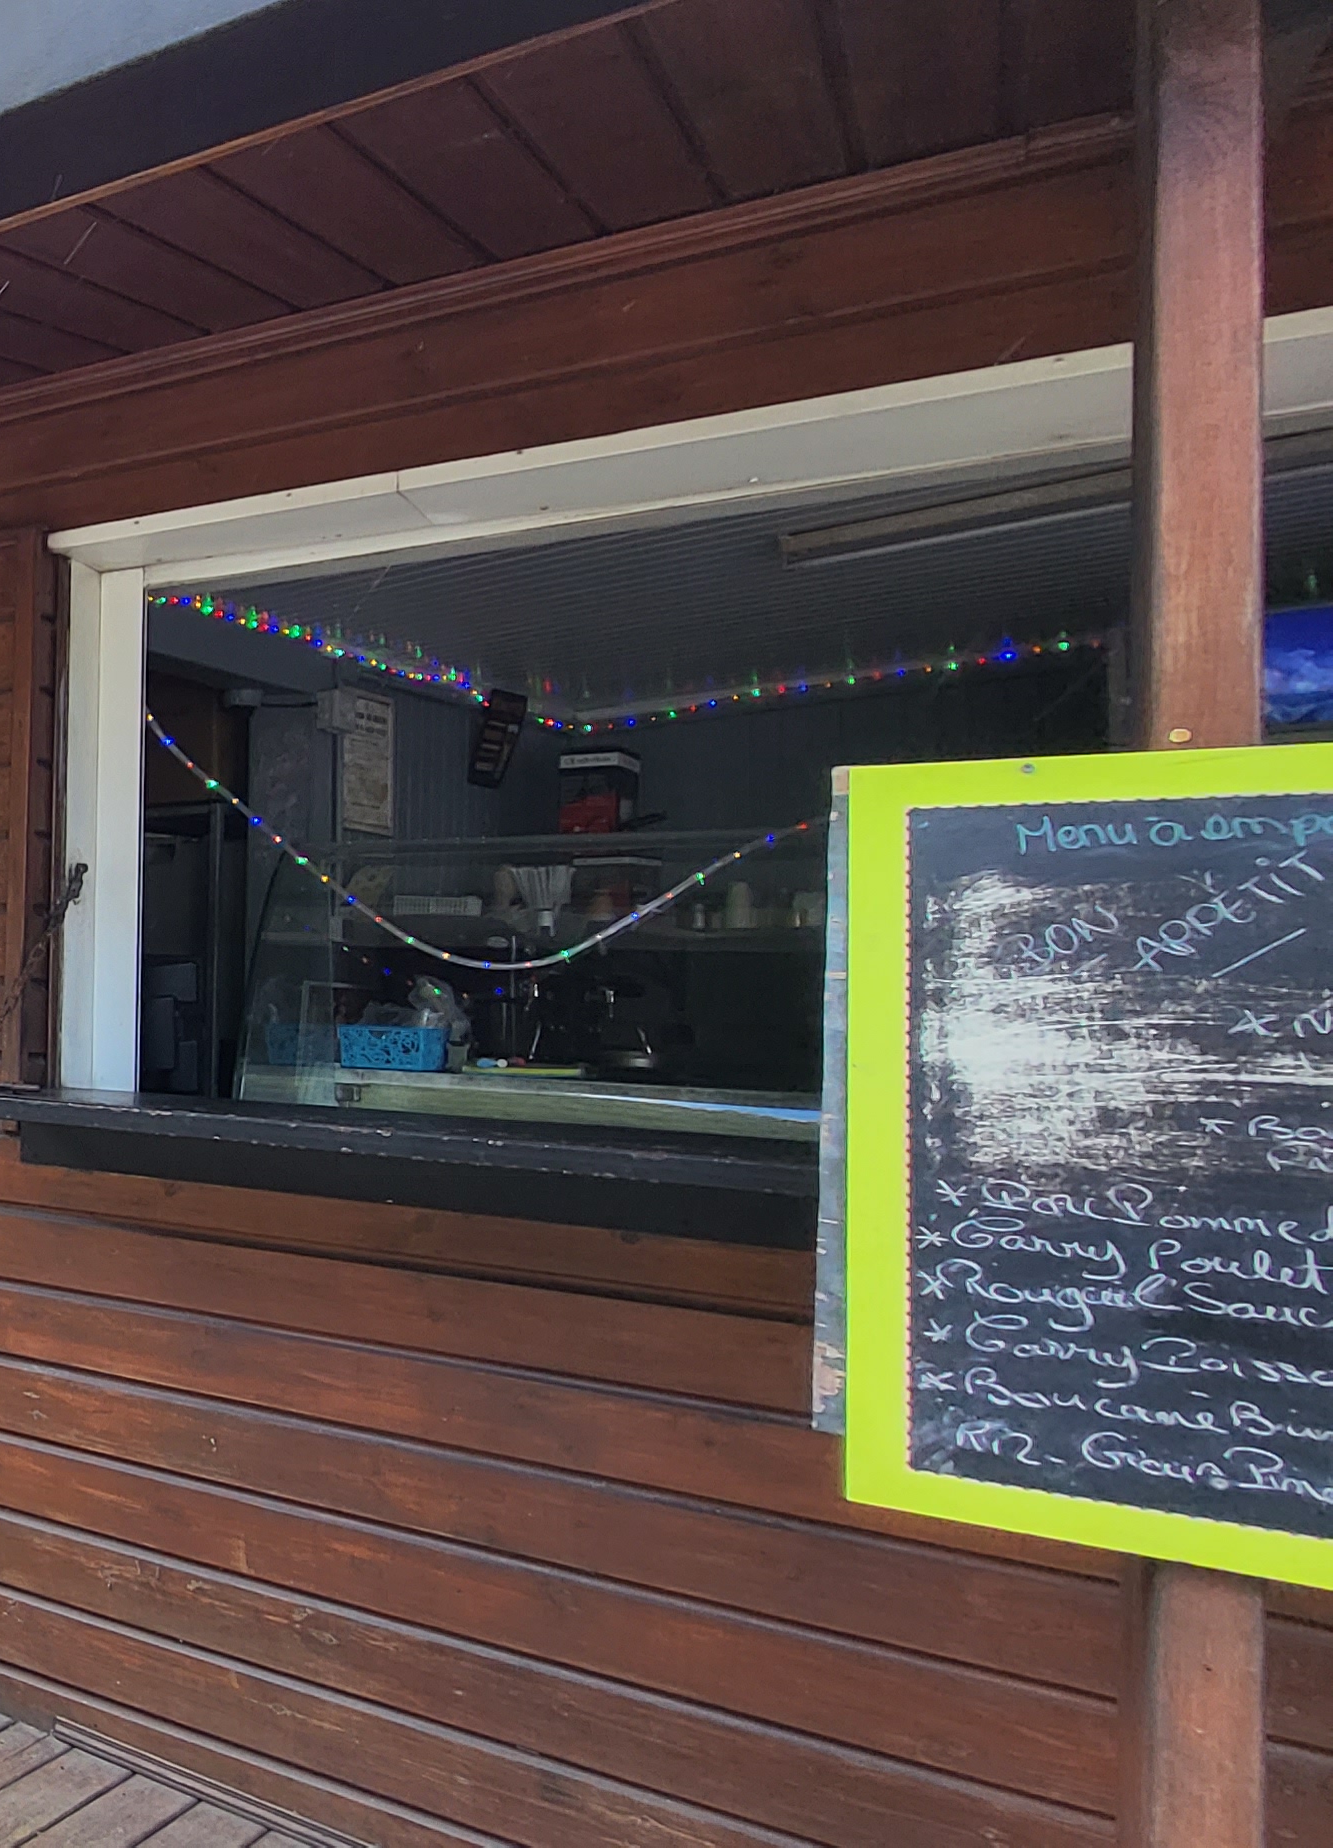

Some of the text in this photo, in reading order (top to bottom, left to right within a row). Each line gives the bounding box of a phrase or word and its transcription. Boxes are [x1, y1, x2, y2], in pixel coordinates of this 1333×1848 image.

[1016, 815, 1139, 855] Menu
[1106, 1183, 1307, 1245] Pomme
[1148, 1239, 1333, 1295] Poulet
